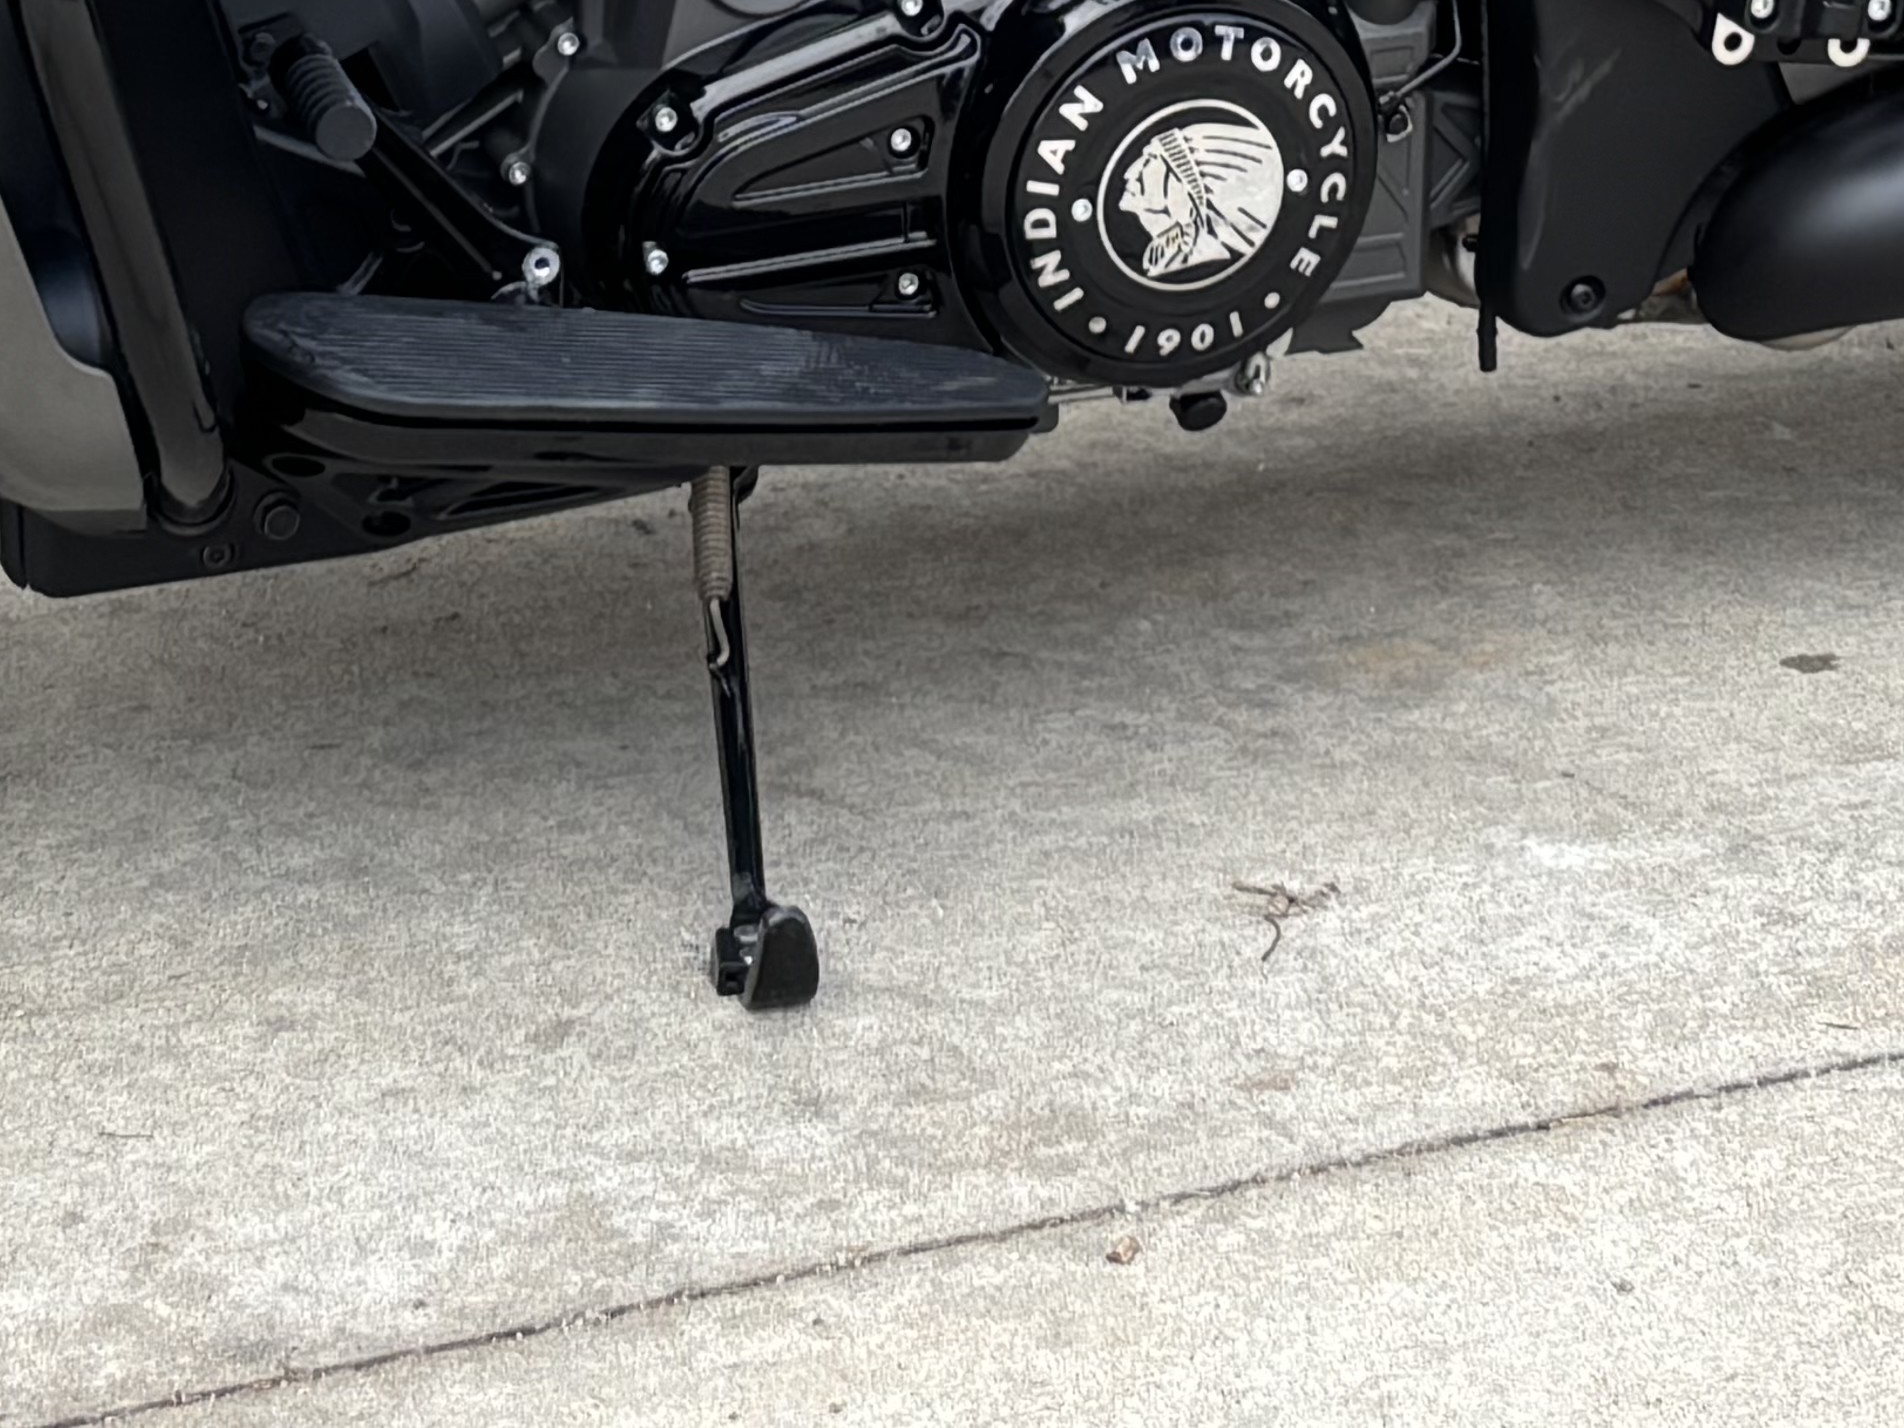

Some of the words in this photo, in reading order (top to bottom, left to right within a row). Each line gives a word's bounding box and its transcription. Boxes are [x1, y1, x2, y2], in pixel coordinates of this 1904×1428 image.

[1023, 84, 1105, 312] INDIAN
[1115, 24, 1349, 278] MOTORCYCLE
[1124, 310, 1245, 357] 1901
